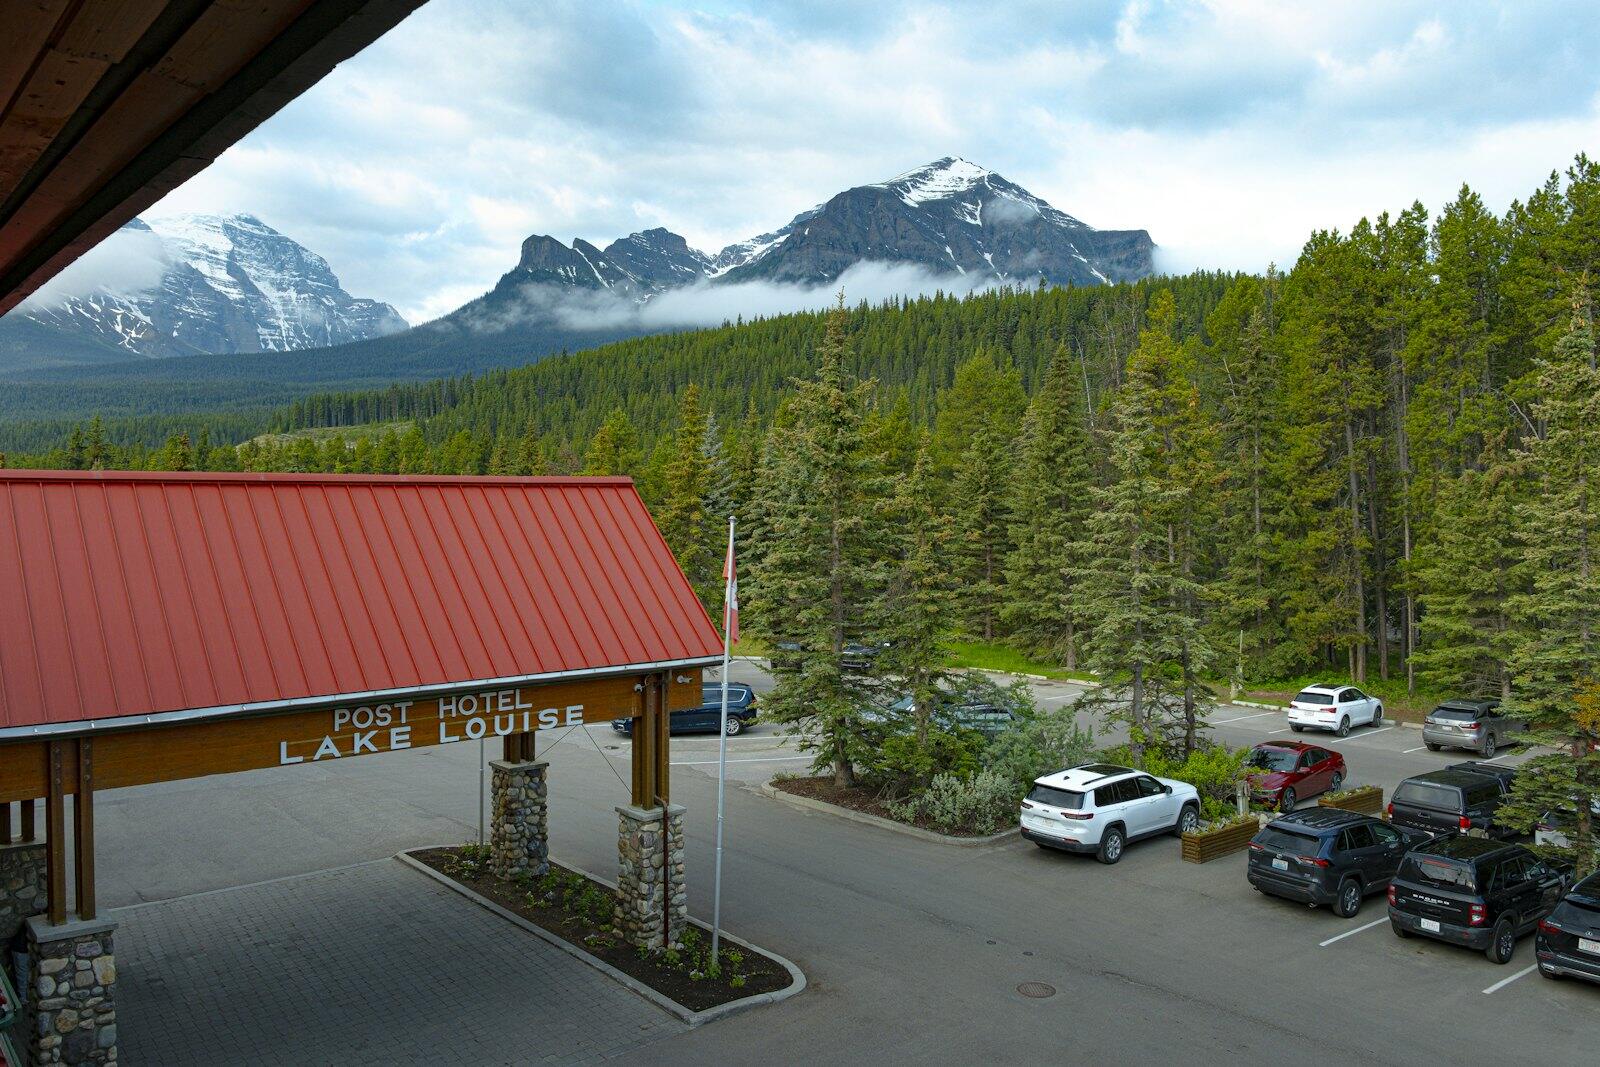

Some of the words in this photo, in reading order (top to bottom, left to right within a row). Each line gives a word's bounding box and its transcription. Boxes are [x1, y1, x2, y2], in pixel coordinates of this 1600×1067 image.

[280, 725, 412, 765] LAKE
[439, 704, 584, 744] LOUISE
[334, 701, 413, 732] POST
[439, 688, 533, 719] HOTEL
